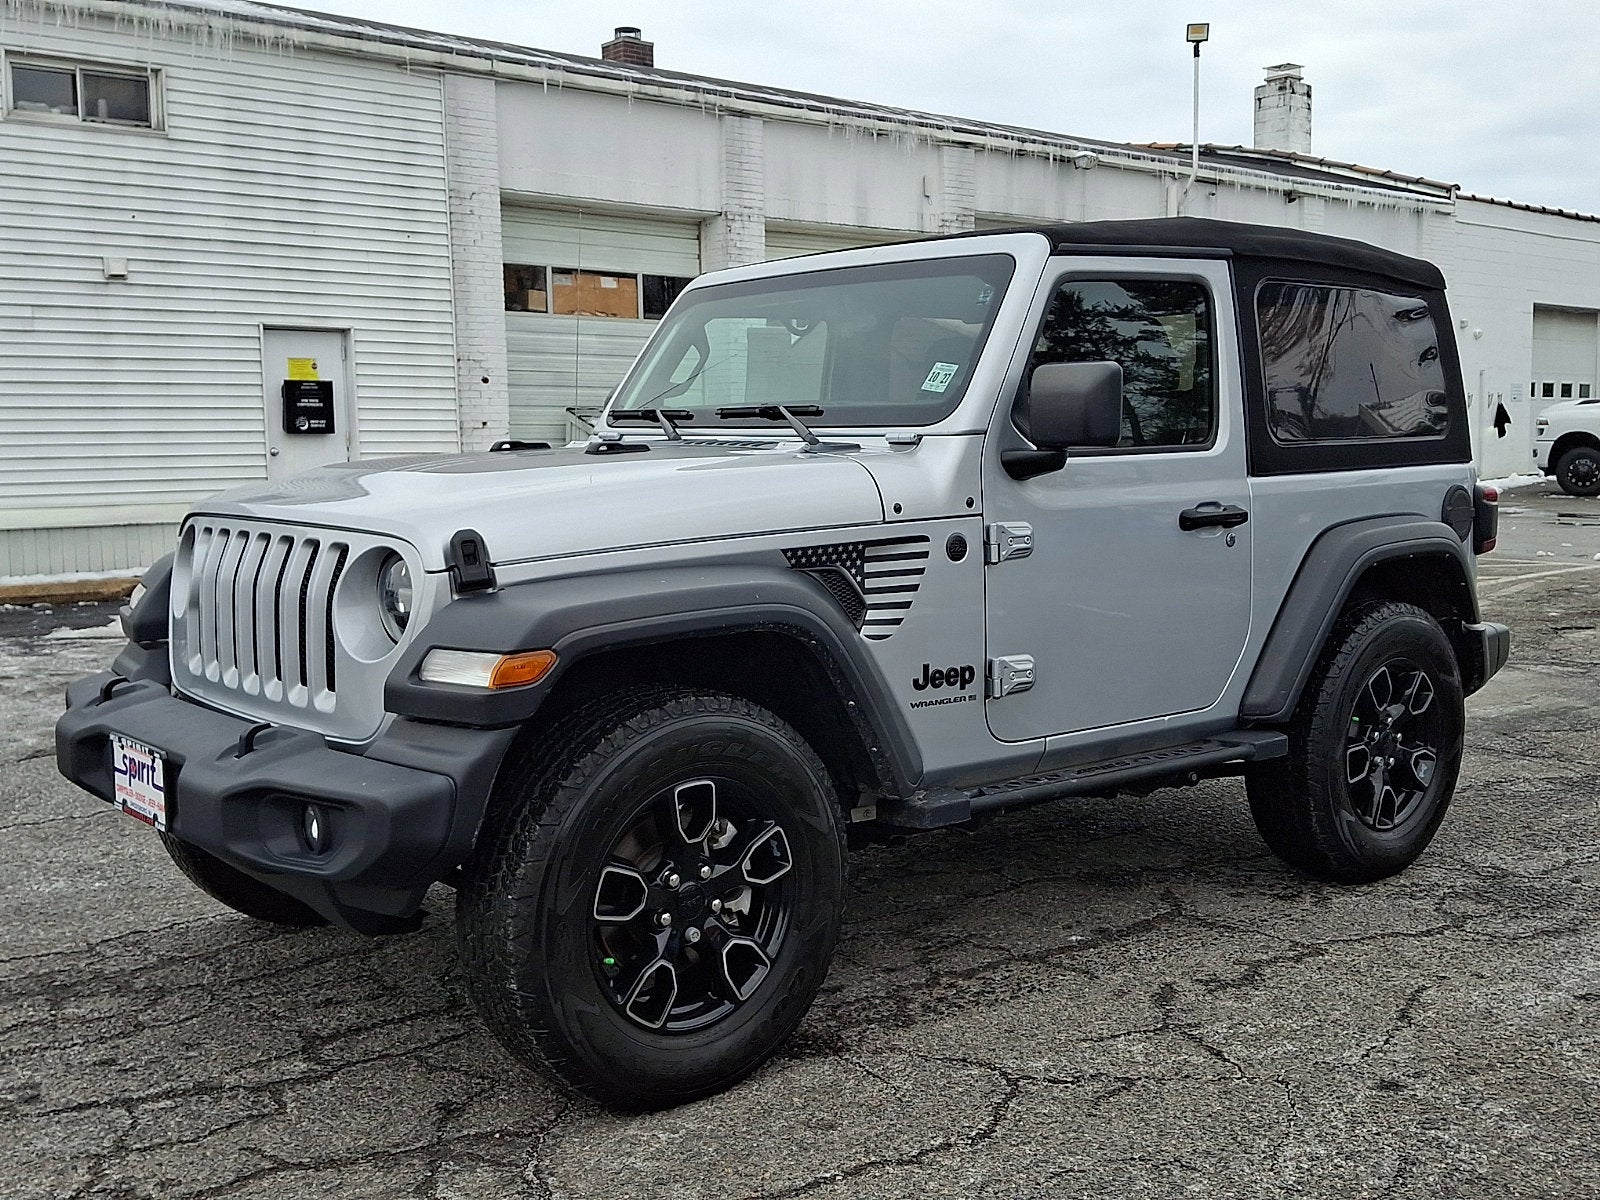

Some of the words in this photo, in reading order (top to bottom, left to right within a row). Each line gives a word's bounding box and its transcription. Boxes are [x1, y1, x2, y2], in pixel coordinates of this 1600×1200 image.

[928, 371, 941, 383] 10
[912, 662, 976, 692] Jeep
[909, 695, 967, 710] WRANGLER
